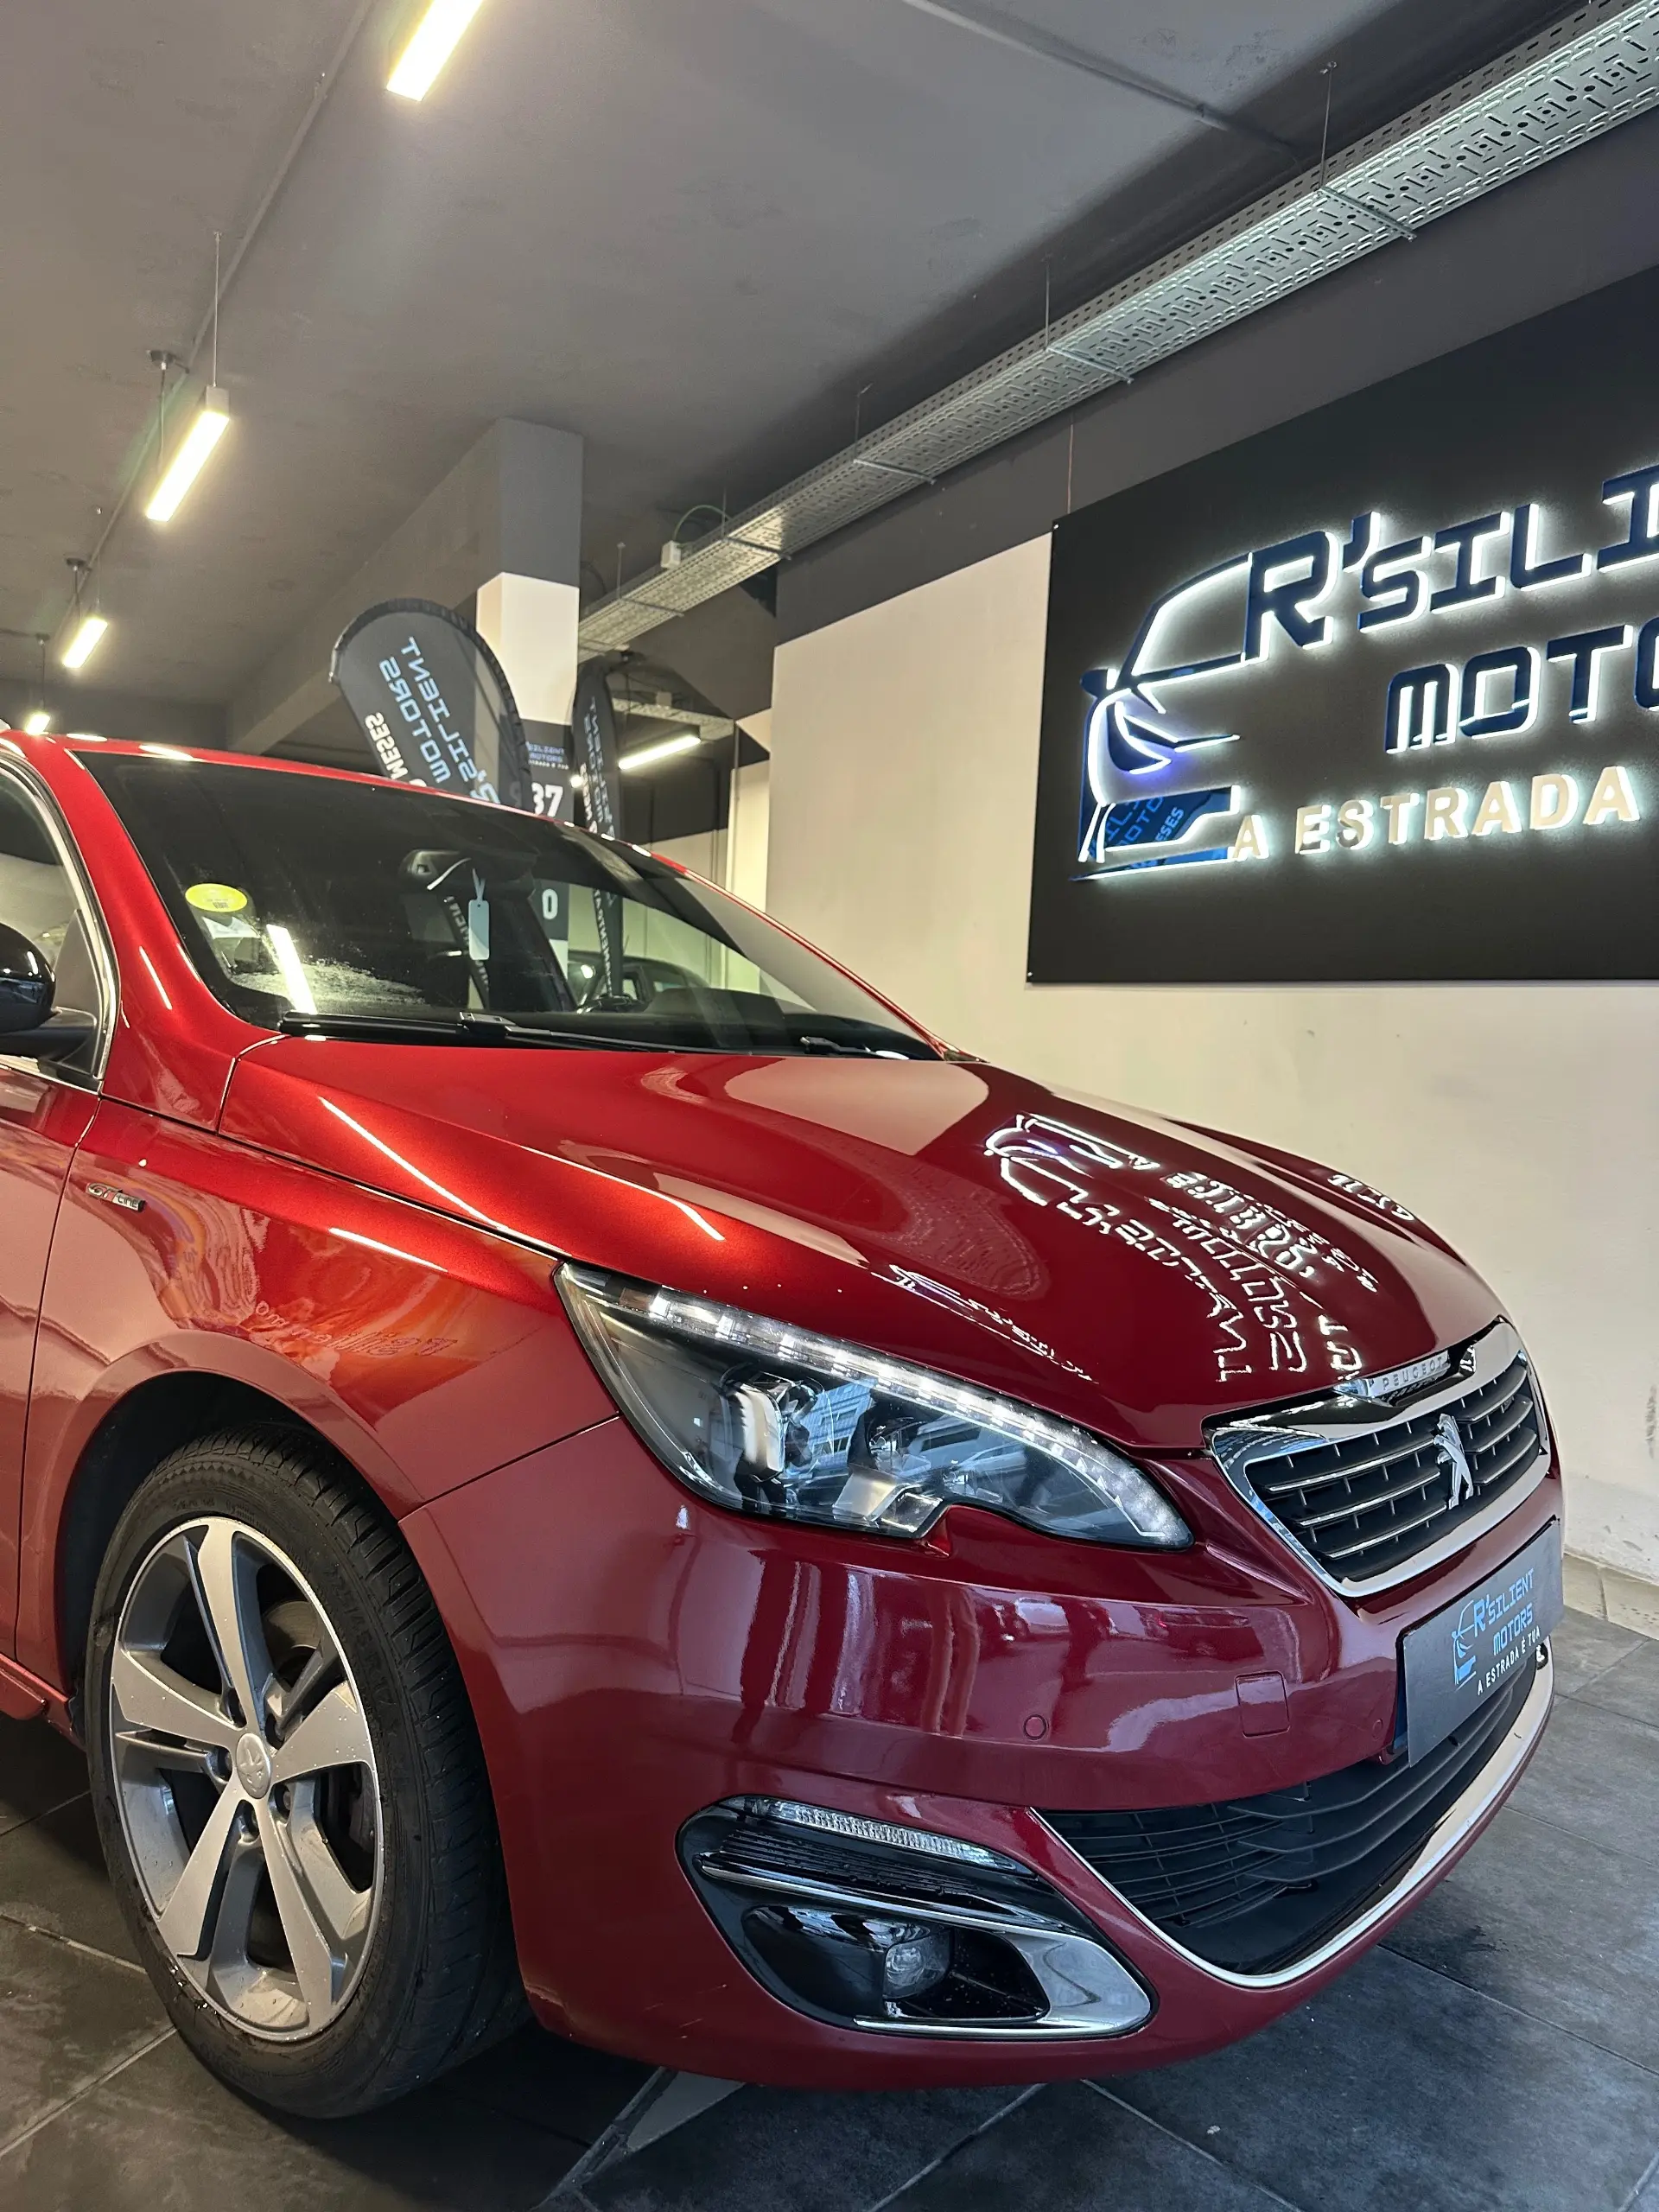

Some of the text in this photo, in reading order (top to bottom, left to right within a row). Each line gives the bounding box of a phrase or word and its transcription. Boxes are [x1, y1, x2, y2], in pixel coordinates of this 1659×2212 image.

[1233, 766, 1641, 861] A ESTRADA
[88, 1183, 122, 1199] GT
[1382, 1356, 1443, 1391] PEUGEOT
[1474, 1568, 1534, 1637] R'SILIENT
[1493, 1603, 1534, 1656] MOTORS
[1478, 1625, 1541, 1695] A ESTRADA É TUA
